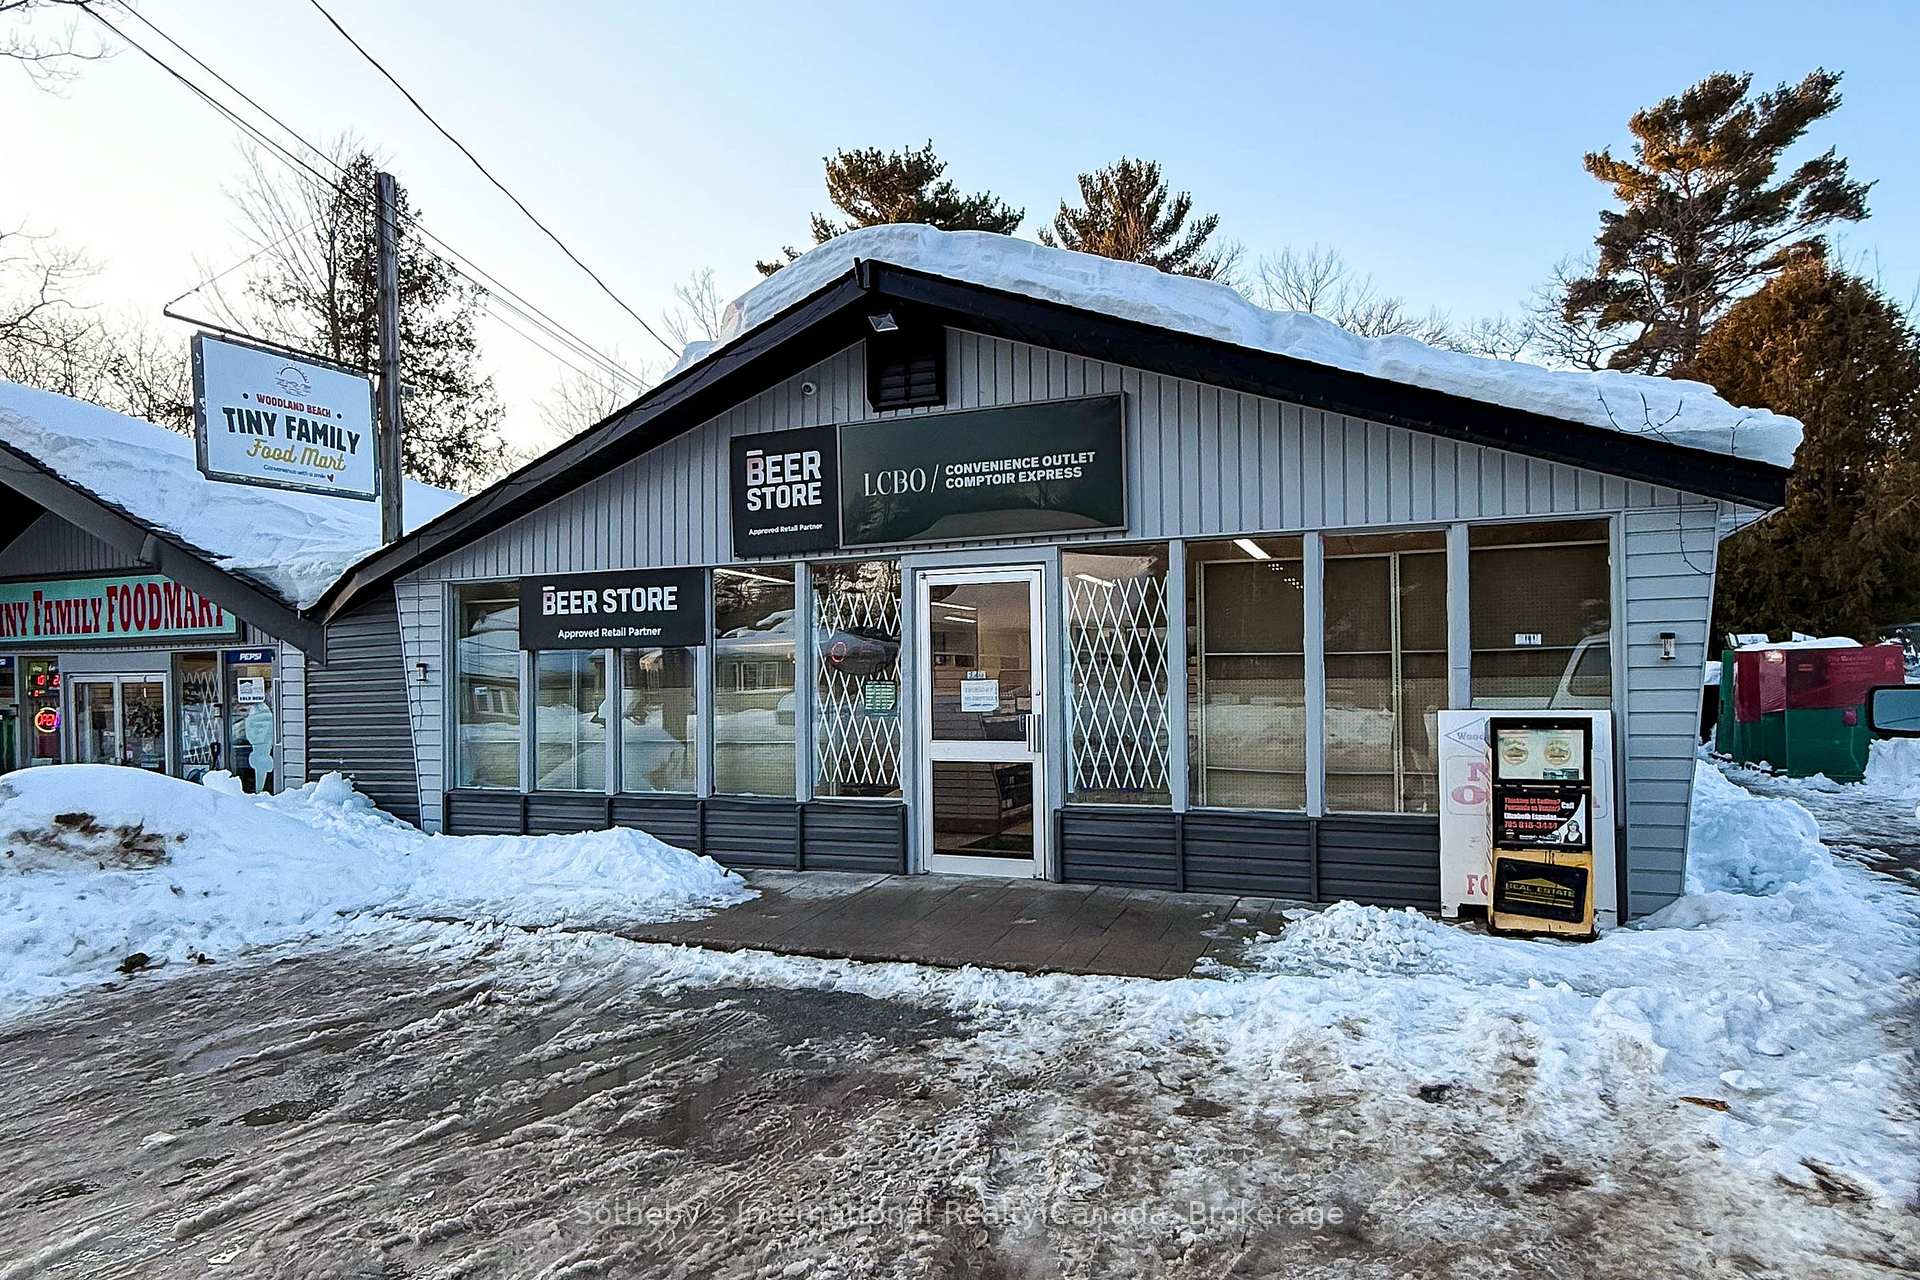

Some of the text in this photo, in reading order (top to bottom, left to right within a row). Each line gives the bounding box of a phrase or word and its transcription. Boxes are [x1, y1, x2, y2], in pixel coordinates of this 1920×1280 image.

[256, 393, 331, 418] WOODLAND BEACH
[222, 407, 360, 454] TINY FAMILY
[246, 438, 346, 471] Food Mart
[945, 451, 1096, 476] CONVENIENCE OUTLET
[863, 467, 927, 497] LCBO
[945, 466, 1083, 489] COMPTOIR EXPRESS
[746, 482, 822, 511] STORE
[748, 523, 823, 536] Approved Retail Partner
[602, 586, 678, 614] STORE
[33, 590, 102, 636] FAMILY
[558, 626, 662, 640] Approved Retail Partner
[240, 652, 262, 661] PEPSI
[1504, 812, 1531, 820] Elizabeth
[1504, 820, 1518, 828] 705
[1536, 886, 1575, 898] ESTATE
